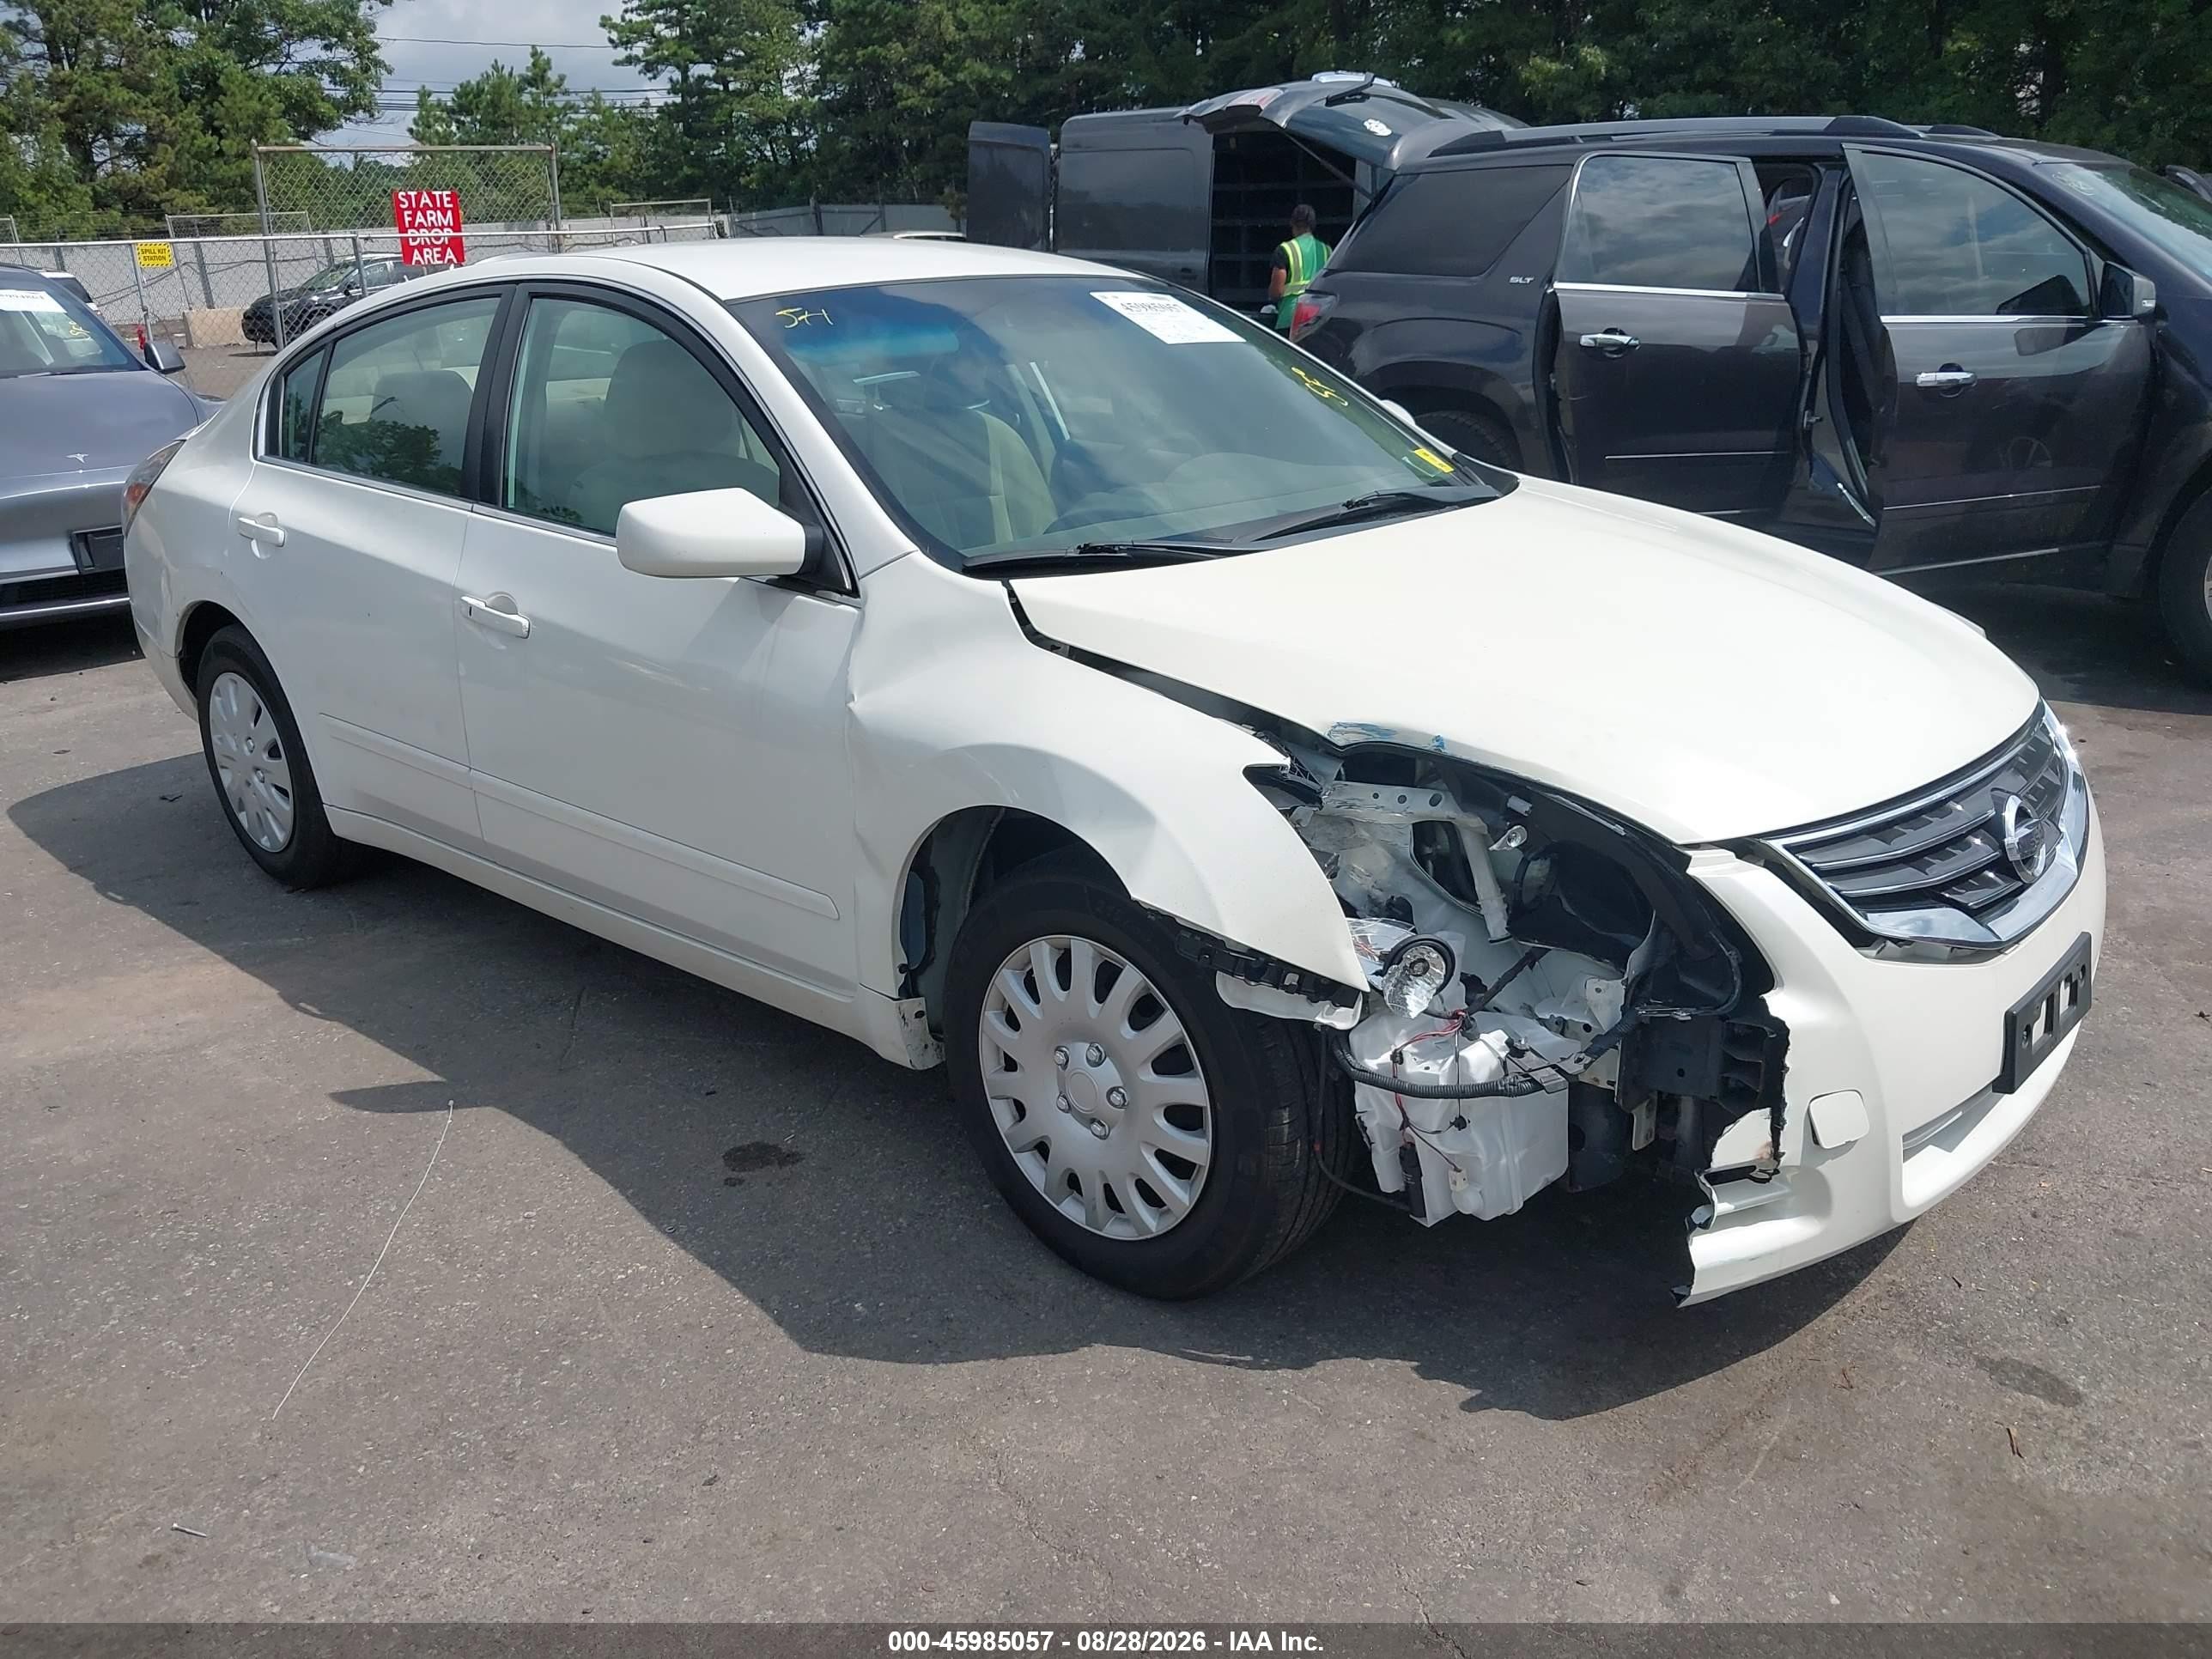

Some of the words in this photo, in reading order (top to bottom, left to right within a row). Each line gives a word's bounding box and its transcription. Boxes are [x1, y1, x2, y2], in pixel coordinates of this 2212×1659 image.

[398, 191, 453, 209] STATE
[404, 210, 453, 228] FARM
[407, 228, 454, 246] DROP
[411, 246, 458, 265] AREA
